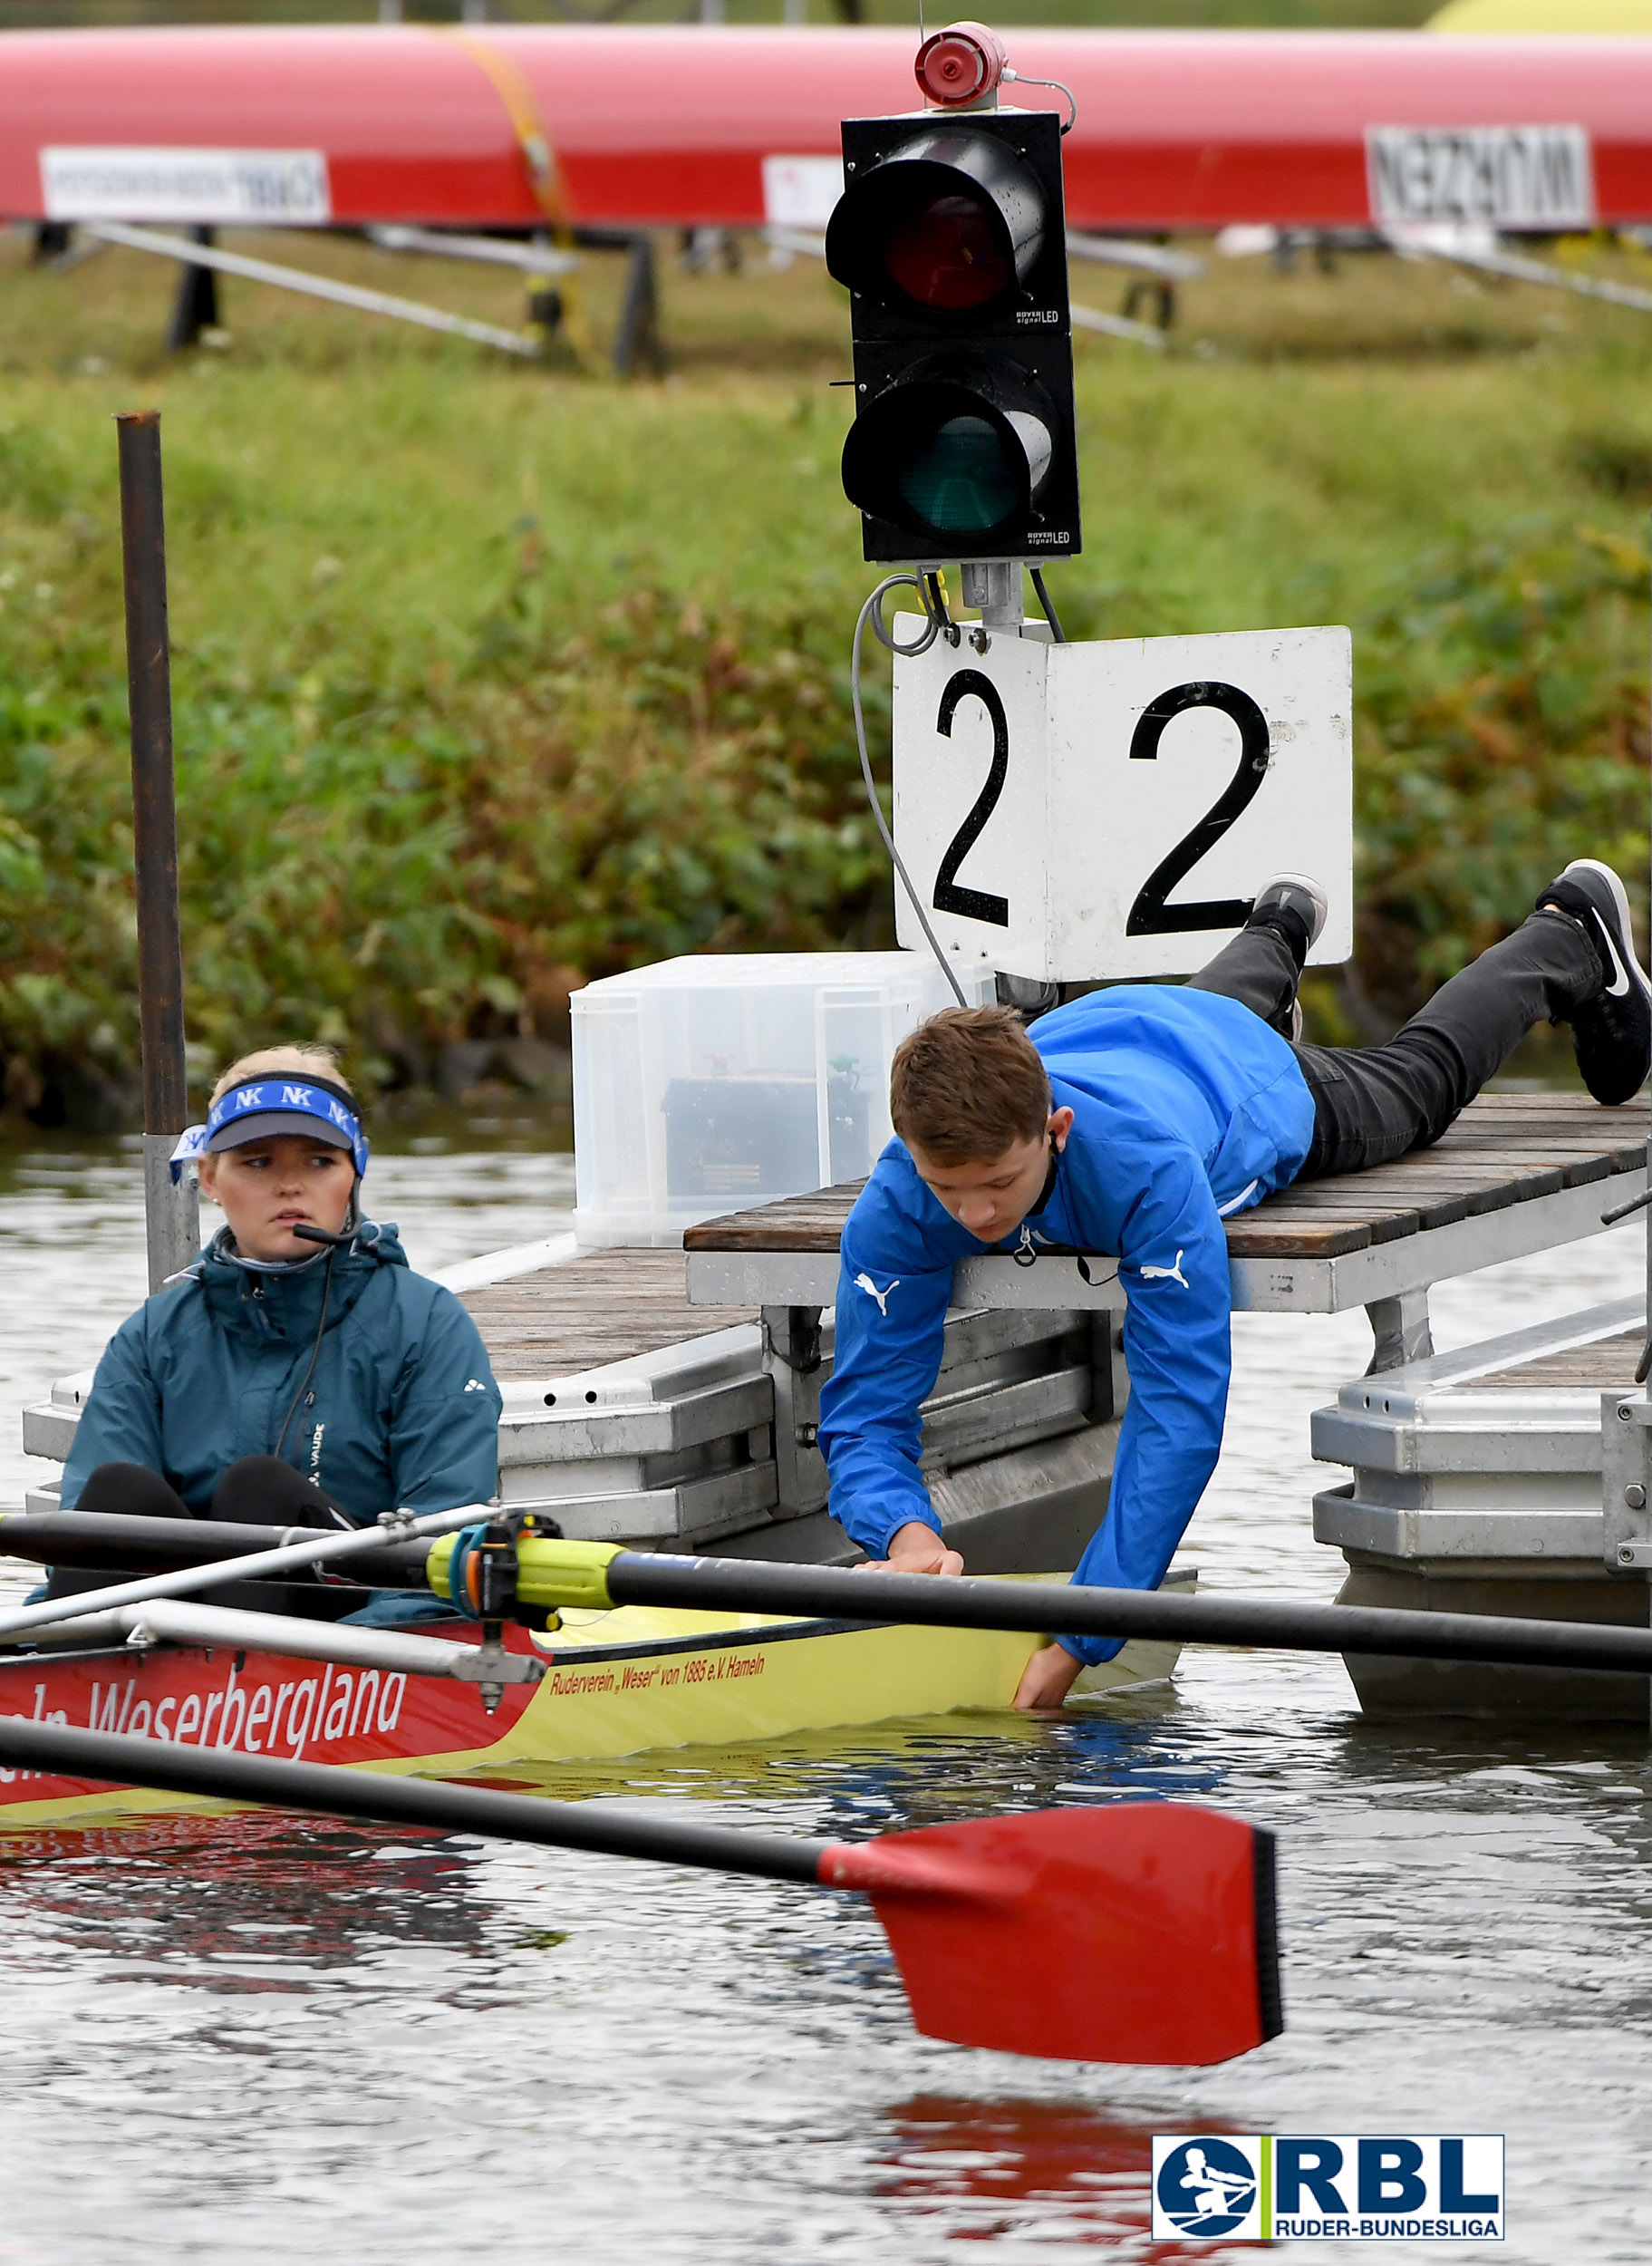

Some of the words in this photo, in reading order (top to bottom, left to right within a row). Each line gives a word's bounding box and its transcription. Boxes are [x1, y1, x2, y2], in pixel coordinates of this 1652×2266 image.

[1373, 135, 1579, 218] WURZEN
[1042, 310, 1058, 324] LED
[1053, 531, 1070, 544] LED
[933, 668, 1009, 928] 2
[1125, 681, 1270, 937] 2
[234, 1087, 264, 1110] NK
[281, 1085, 314, 1107] NK
[310, 1423, 325, 1467] VAUDE
[550, 1668, 614, 1696] Ruderverein
[661, 1667, 680, 1686] von
[682, 1660, 708, 1684] 1885
[726, 1652, 765, 1679] Hameln
